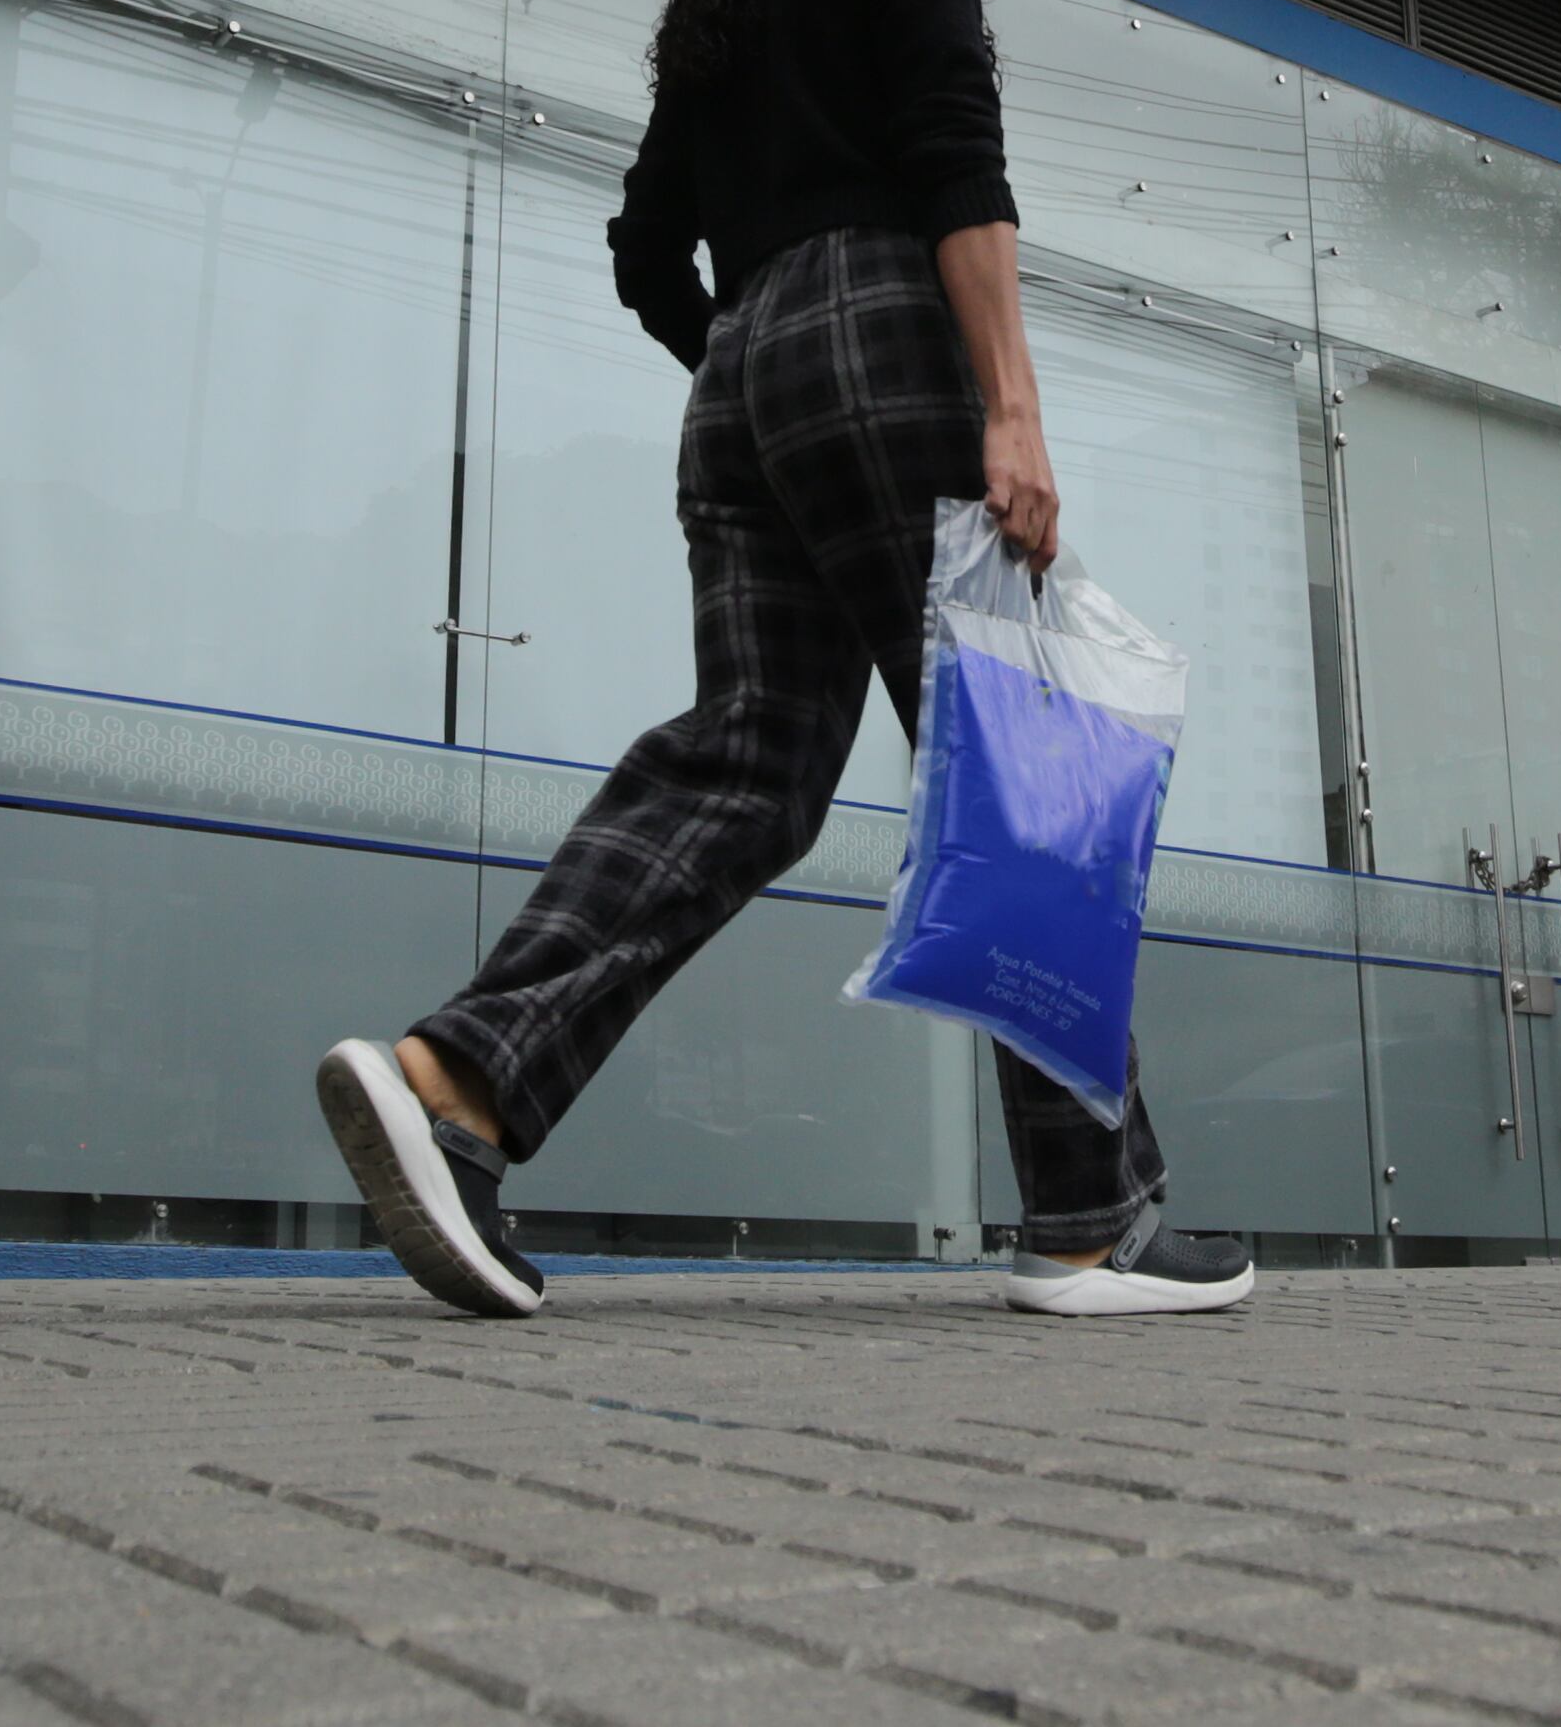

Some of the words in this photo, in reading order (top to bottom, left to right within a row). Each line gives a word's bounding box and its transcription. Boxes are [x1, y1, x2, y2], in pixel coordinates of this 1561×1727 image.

[986, 945, 1020, 970] Agua
[1022, 959, 1064, 990] Potable
[1066, 979, 1102, 1011] Tratada
